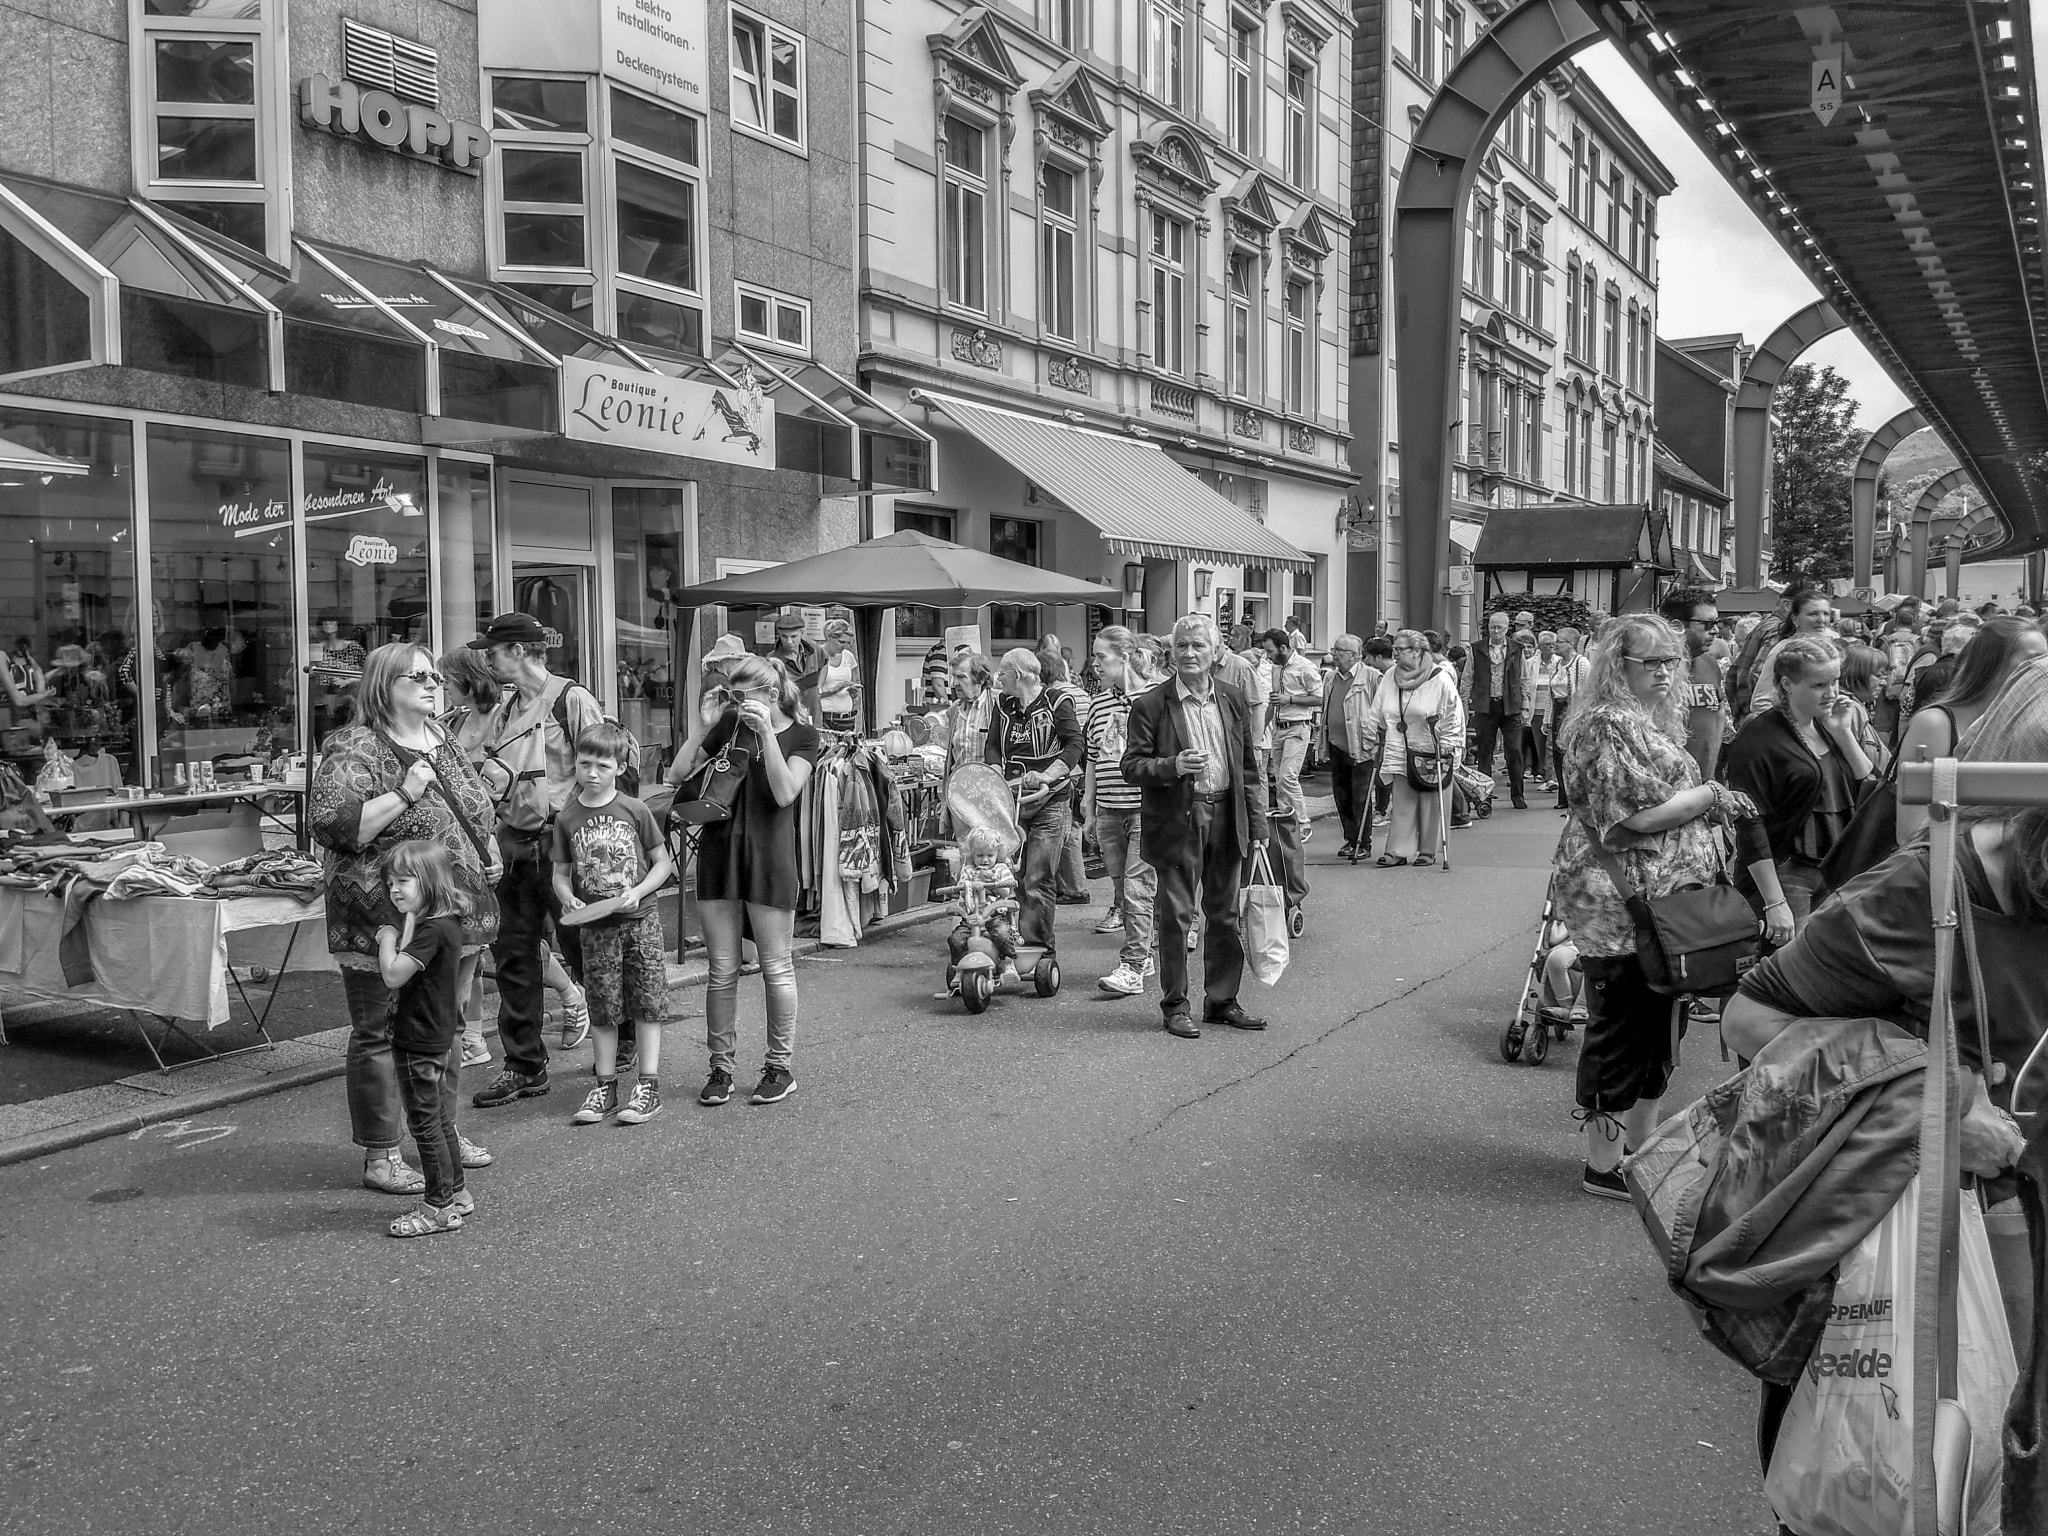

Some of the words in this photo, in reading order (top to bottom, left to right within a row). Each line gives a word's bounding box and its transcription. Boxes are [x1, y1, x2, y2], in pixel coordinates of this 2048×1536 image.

[635, 0, 672, 22] Elektro
[617, 6, 690, 51] installationen
[616, 49, 699, 94] Deckensysteme
[1816, 68, 1836, 92] A
[1819, 102, 1834, 112] 55
[302, 72, 492, 168] HOPP
[611, 379, 657, 397] Boutique
[572, 373, 685, 436] Leonie
[218, 502, 260, 527] Mode
[263, 499, 286, 519] der
[304, 487, 366, 512] besonderen
[348, 539, 395, 564] Leonie
[587, 815, 613, 827] DINO
